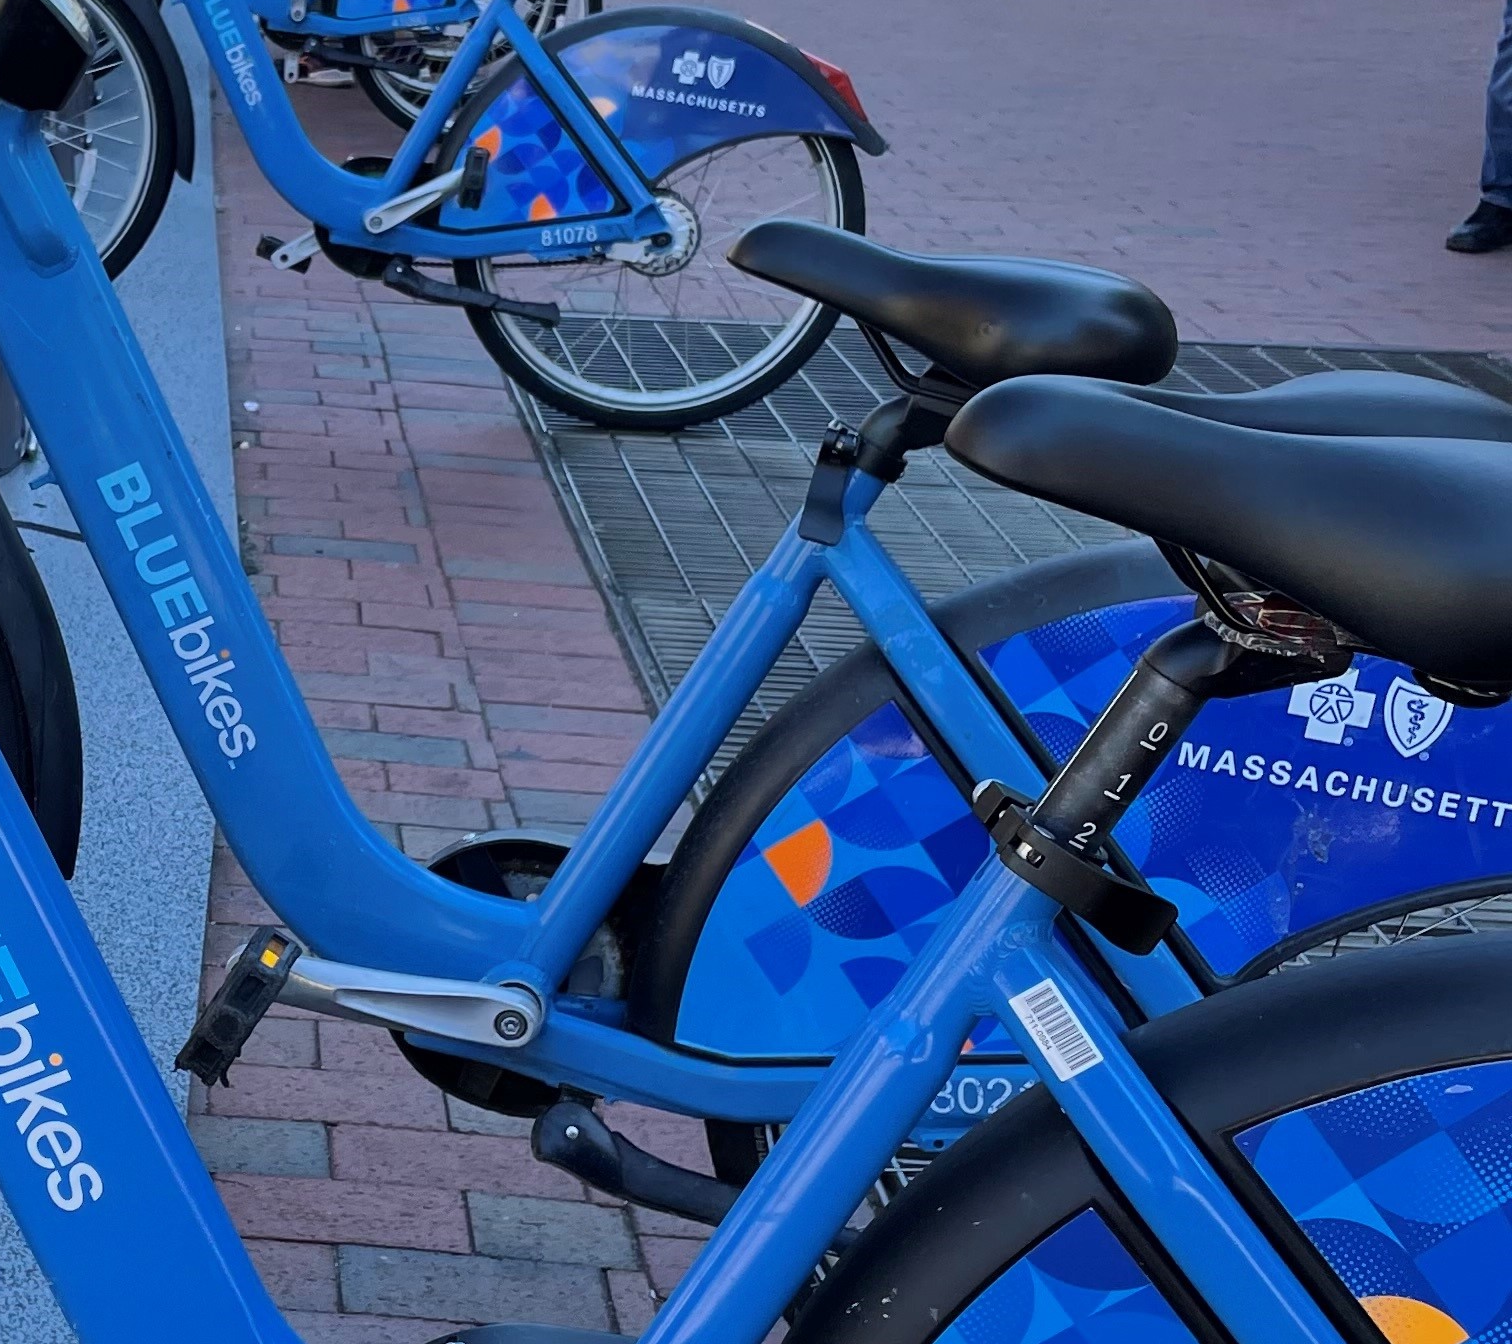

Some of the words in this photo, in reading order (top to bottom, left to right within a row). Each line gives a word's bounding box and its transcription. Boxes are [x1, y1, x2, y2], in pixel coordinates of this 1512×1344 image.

[630, 83, 767, 119] MASSACHUSETTS
[540, 224, 598, 247] 81078
[96, 461, 257, 760] BLUEbikes
[1176, 740, 1512, 830] MASSACHUSETT
[1024, 1014, 1052, 1051] 711-0984
[929, 1076, 1036, 1115] 802
